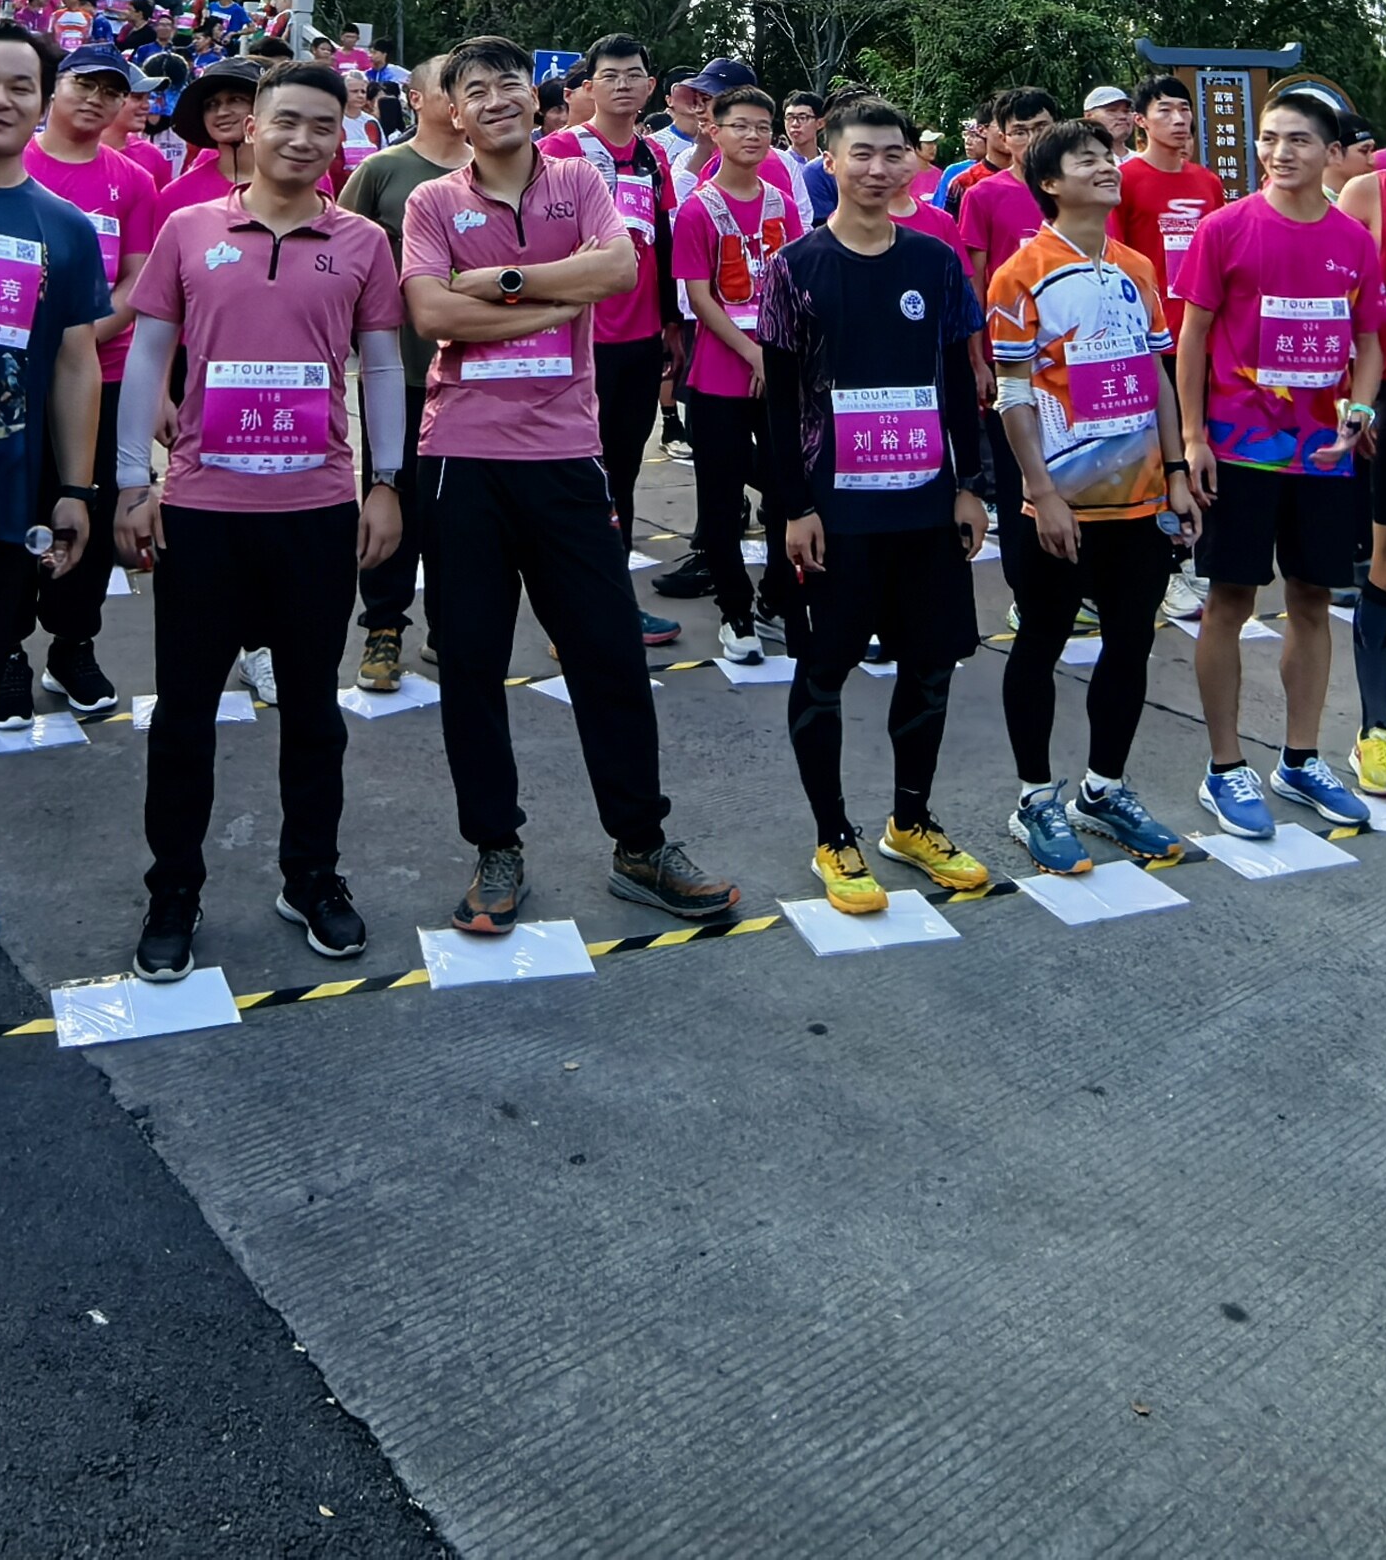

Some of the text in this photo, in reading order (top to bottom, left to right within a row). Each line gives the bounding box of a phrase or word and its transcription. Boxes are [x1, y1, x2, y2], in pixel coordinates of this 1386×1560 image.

[1215, 104, 1234, 114] 民主
[1216, 124, 1235, 134] 文明
[1218, 156, 1237, 166] 自由
[544, 201, 574, 221] XSC
[315, 253, 340, 276] SL
[259, 392, 281, 402] 118
[240, 408, 294, 431] 孙磊
